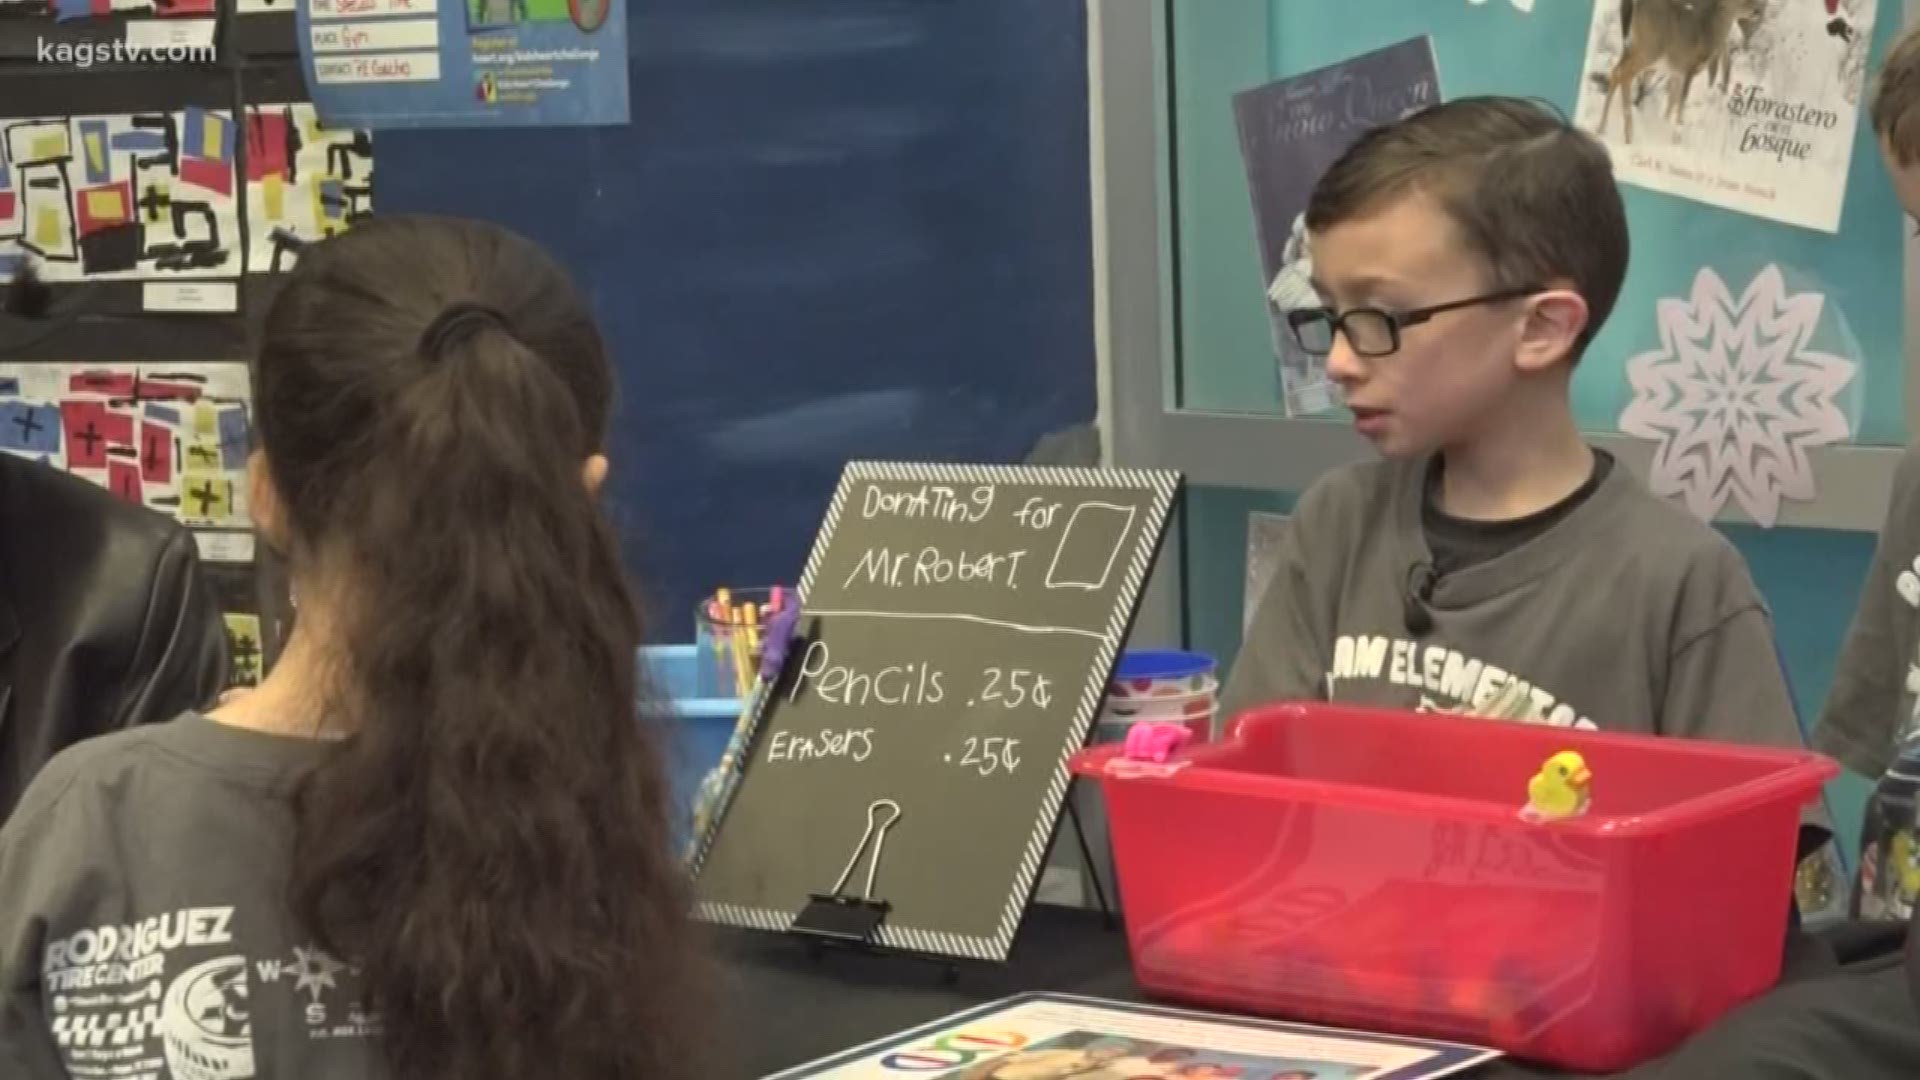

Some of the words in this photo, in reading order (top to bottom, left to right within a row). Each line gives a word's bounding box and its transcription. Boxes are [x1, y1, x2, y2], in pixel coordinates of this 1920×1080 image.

[1743, 84, 1838, 129] Forastero
[1739, 121, 1812, 163] bosque
[1013, 496, 1062, 530] for
[789, 640, 945, 706] Pencils
[44, 906, 235, 973] RODRIGUEZ
[46, 965, 95, 992] TIRE
[95, 952, 165, 985] CENTER
